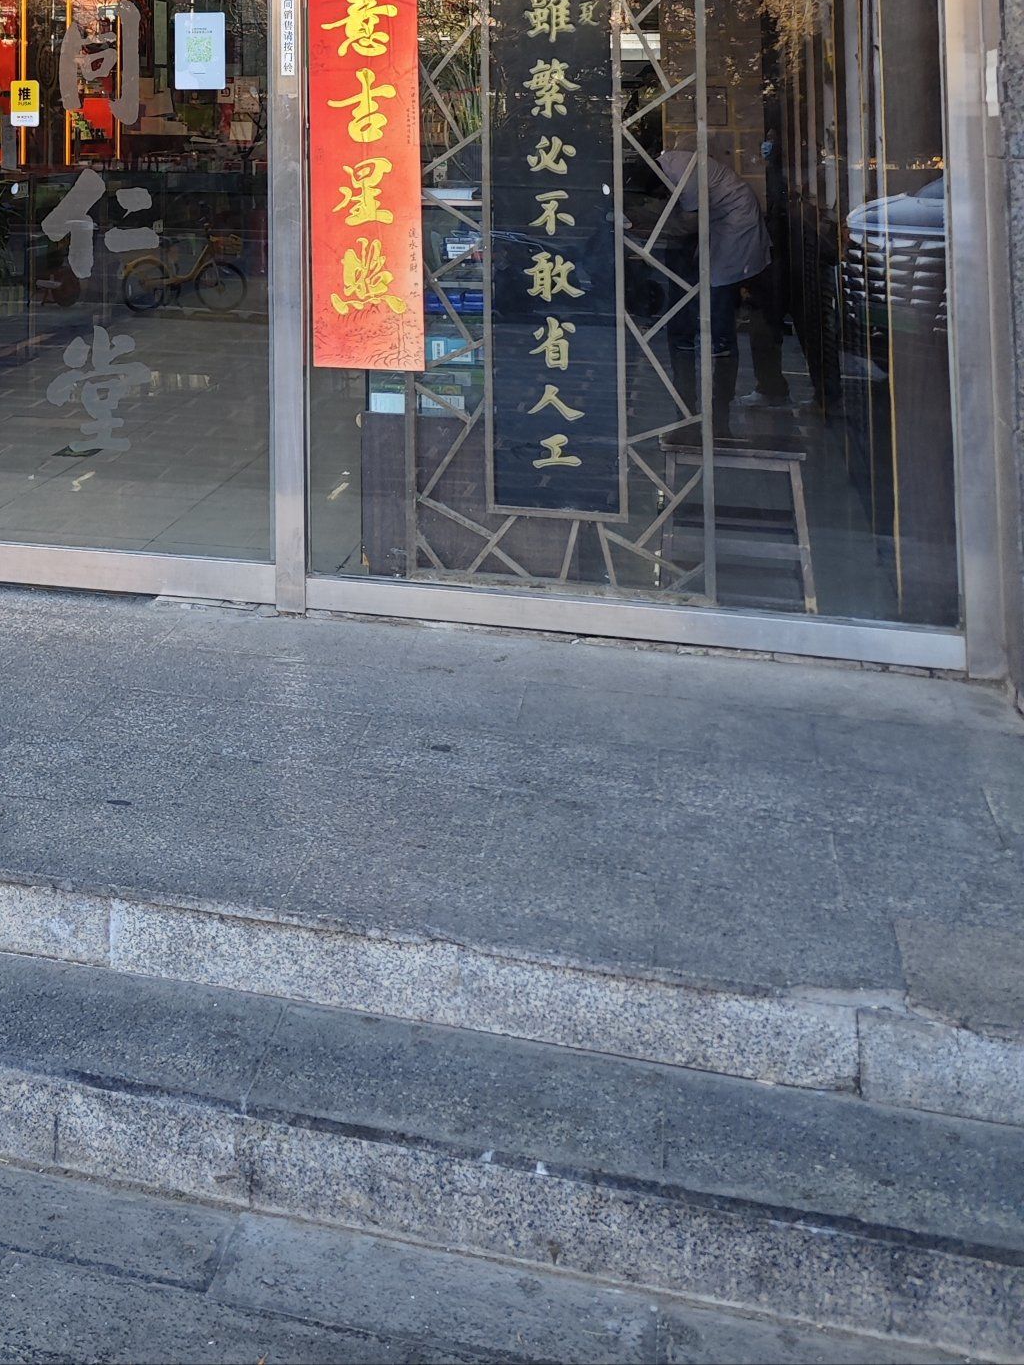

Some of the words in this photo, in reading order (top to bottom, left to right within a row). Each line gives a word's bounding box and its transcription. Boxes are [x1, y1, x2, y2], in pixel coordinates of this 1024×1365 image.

[18, 86, 31, 101] 推
[41, 0, 161, 452] 同仁堂
